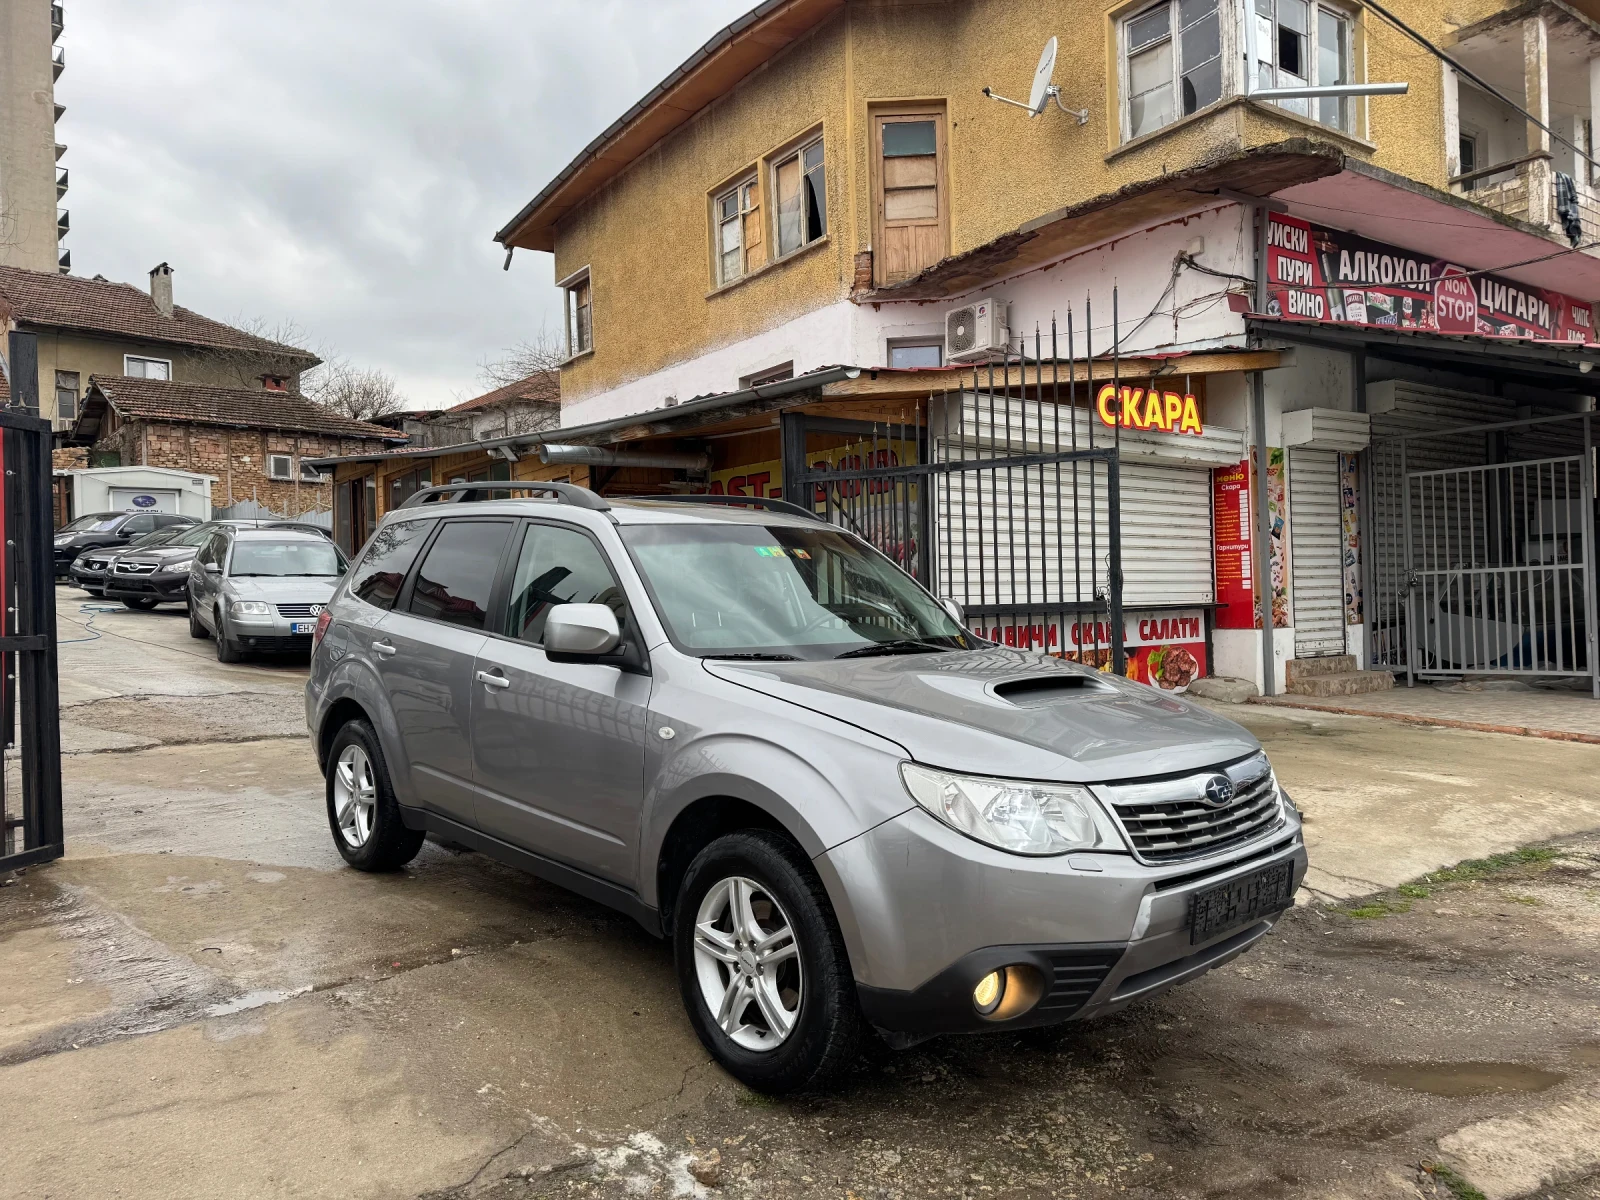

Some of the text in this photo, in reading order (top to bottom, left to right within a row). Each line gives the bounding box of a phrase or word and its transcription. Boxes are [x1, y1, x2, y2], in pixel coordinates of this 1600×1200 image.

[1267, 221, 1308, 254] УИСКИ
[1277, 255, 1313, 287] ПУРИ
[1338, 249, 1550, 330] АЛКОХОЛ ЦИГАРИ
[1444, 279, 1467, 296] NON
[1288, 289, 1324, 319] ВИНО
[1438, 294, 1474, 323] STOP
[1097, 384, 1203, 435] СКАРА
[1138, 617, 1200, 641] САЛАТИ
